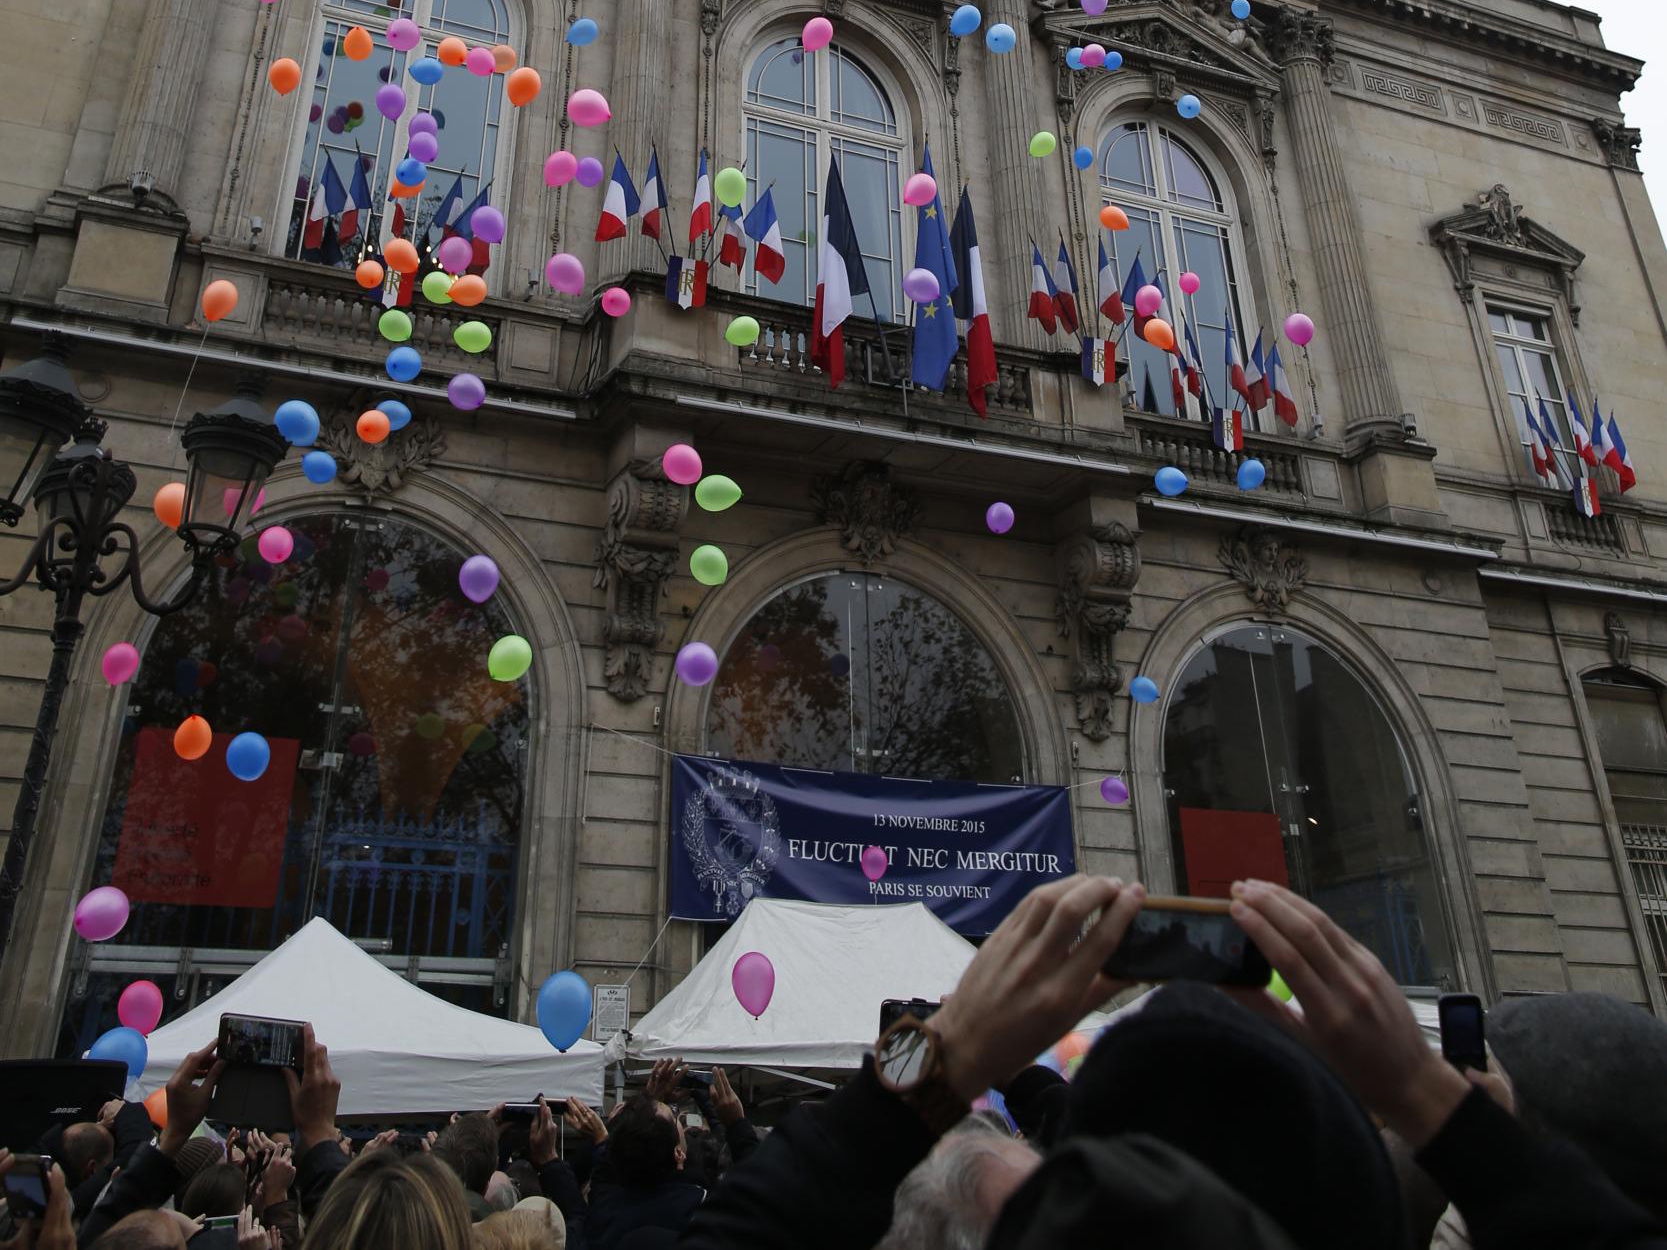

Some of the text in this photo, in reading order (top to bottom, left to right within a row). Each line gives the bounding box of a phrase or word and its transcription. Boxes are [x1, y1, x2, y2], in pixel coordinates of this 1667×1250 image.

[873, 813, 986, 834] 13 NOVEMBRE 2015
[787, 838, 1062, 874] FLUCTT NEC MERGITUR
[868, 881, 992, 899] PARIS SE SOUVIENT
